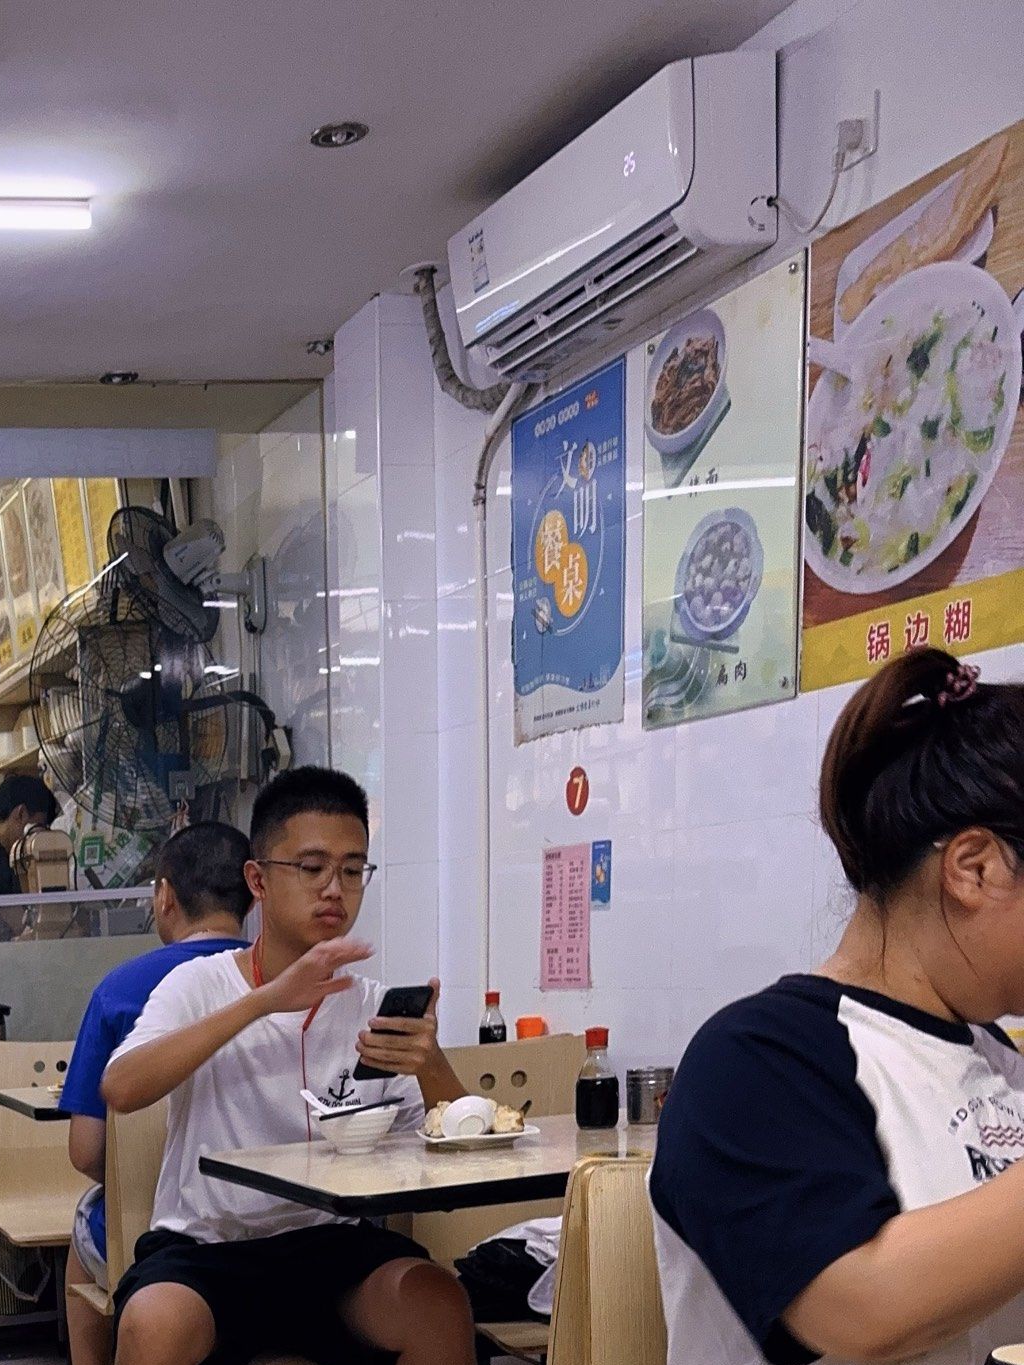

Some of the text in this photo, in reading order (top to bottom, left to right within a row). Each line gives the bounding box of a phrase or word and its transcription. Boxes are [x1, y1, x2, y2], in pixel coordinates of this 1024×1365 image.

[867, 599, 973, 662] 锅边糊
[573, 774, 585, 809] 7
